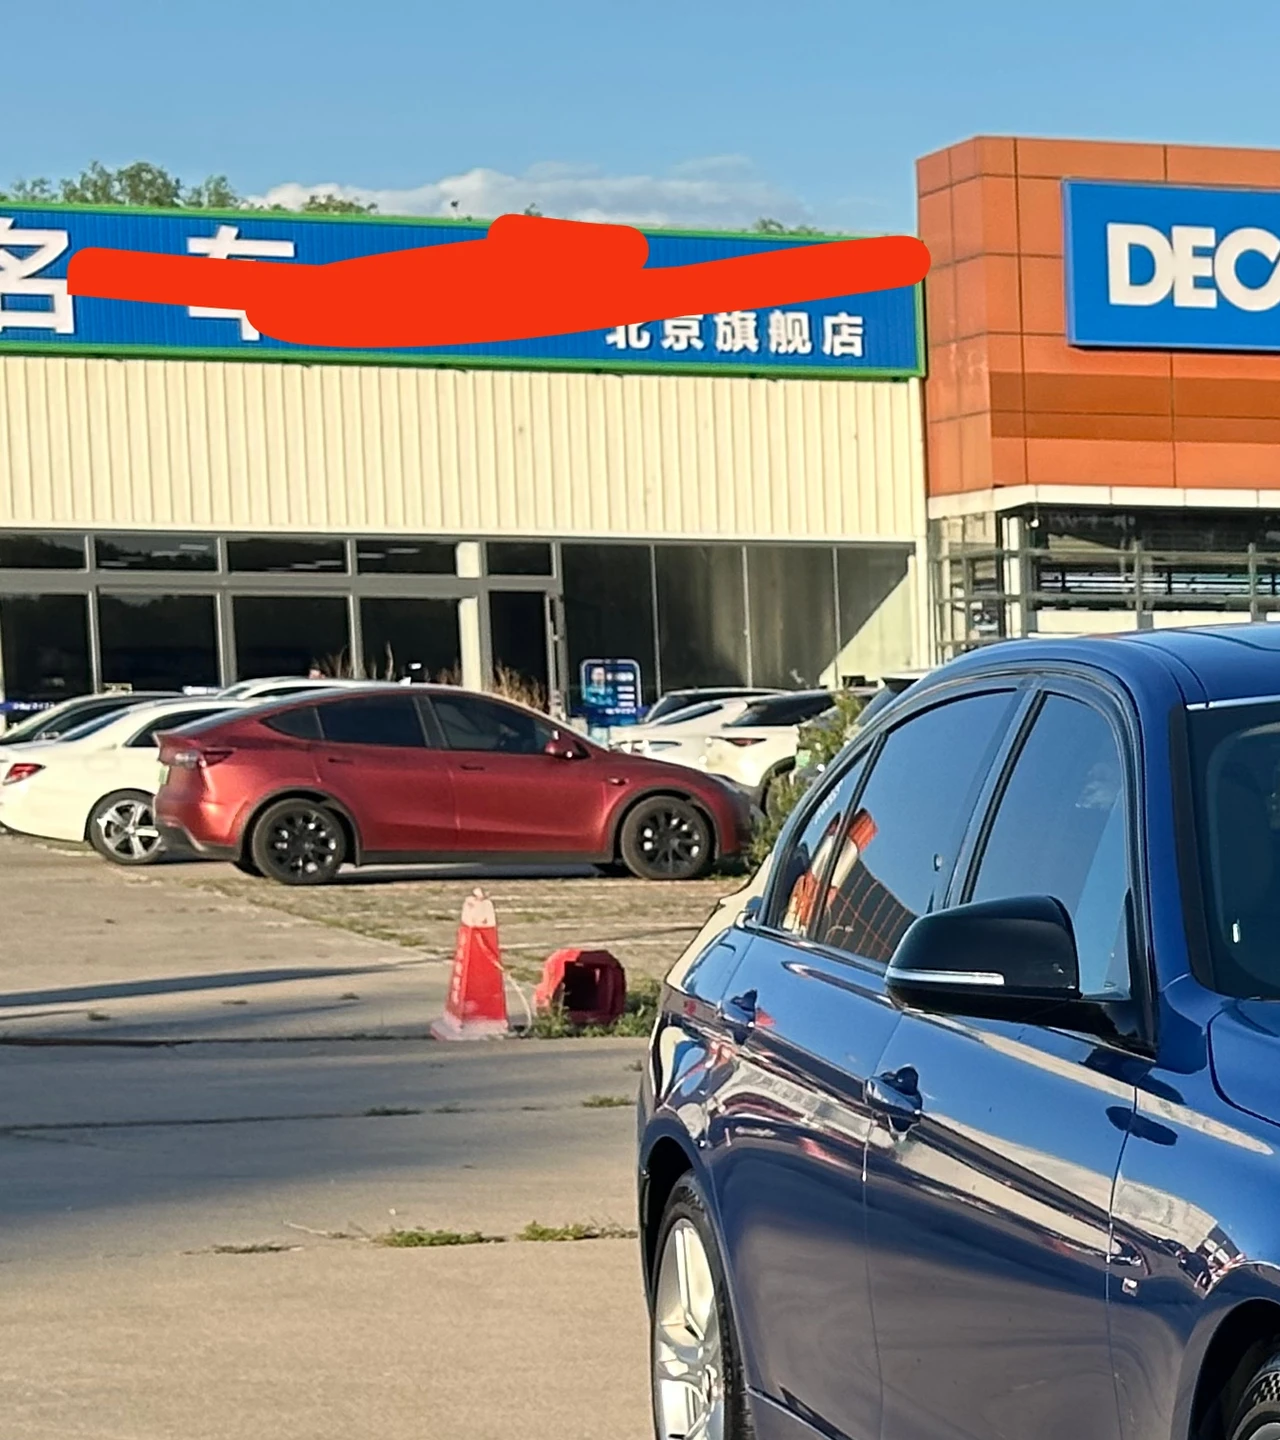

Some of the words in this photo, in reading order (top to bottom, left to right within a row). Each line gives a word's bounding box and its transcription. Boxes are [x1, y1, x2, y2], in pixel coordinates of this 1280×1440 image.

[605, 310, 864, 357] 北京旗舰店
